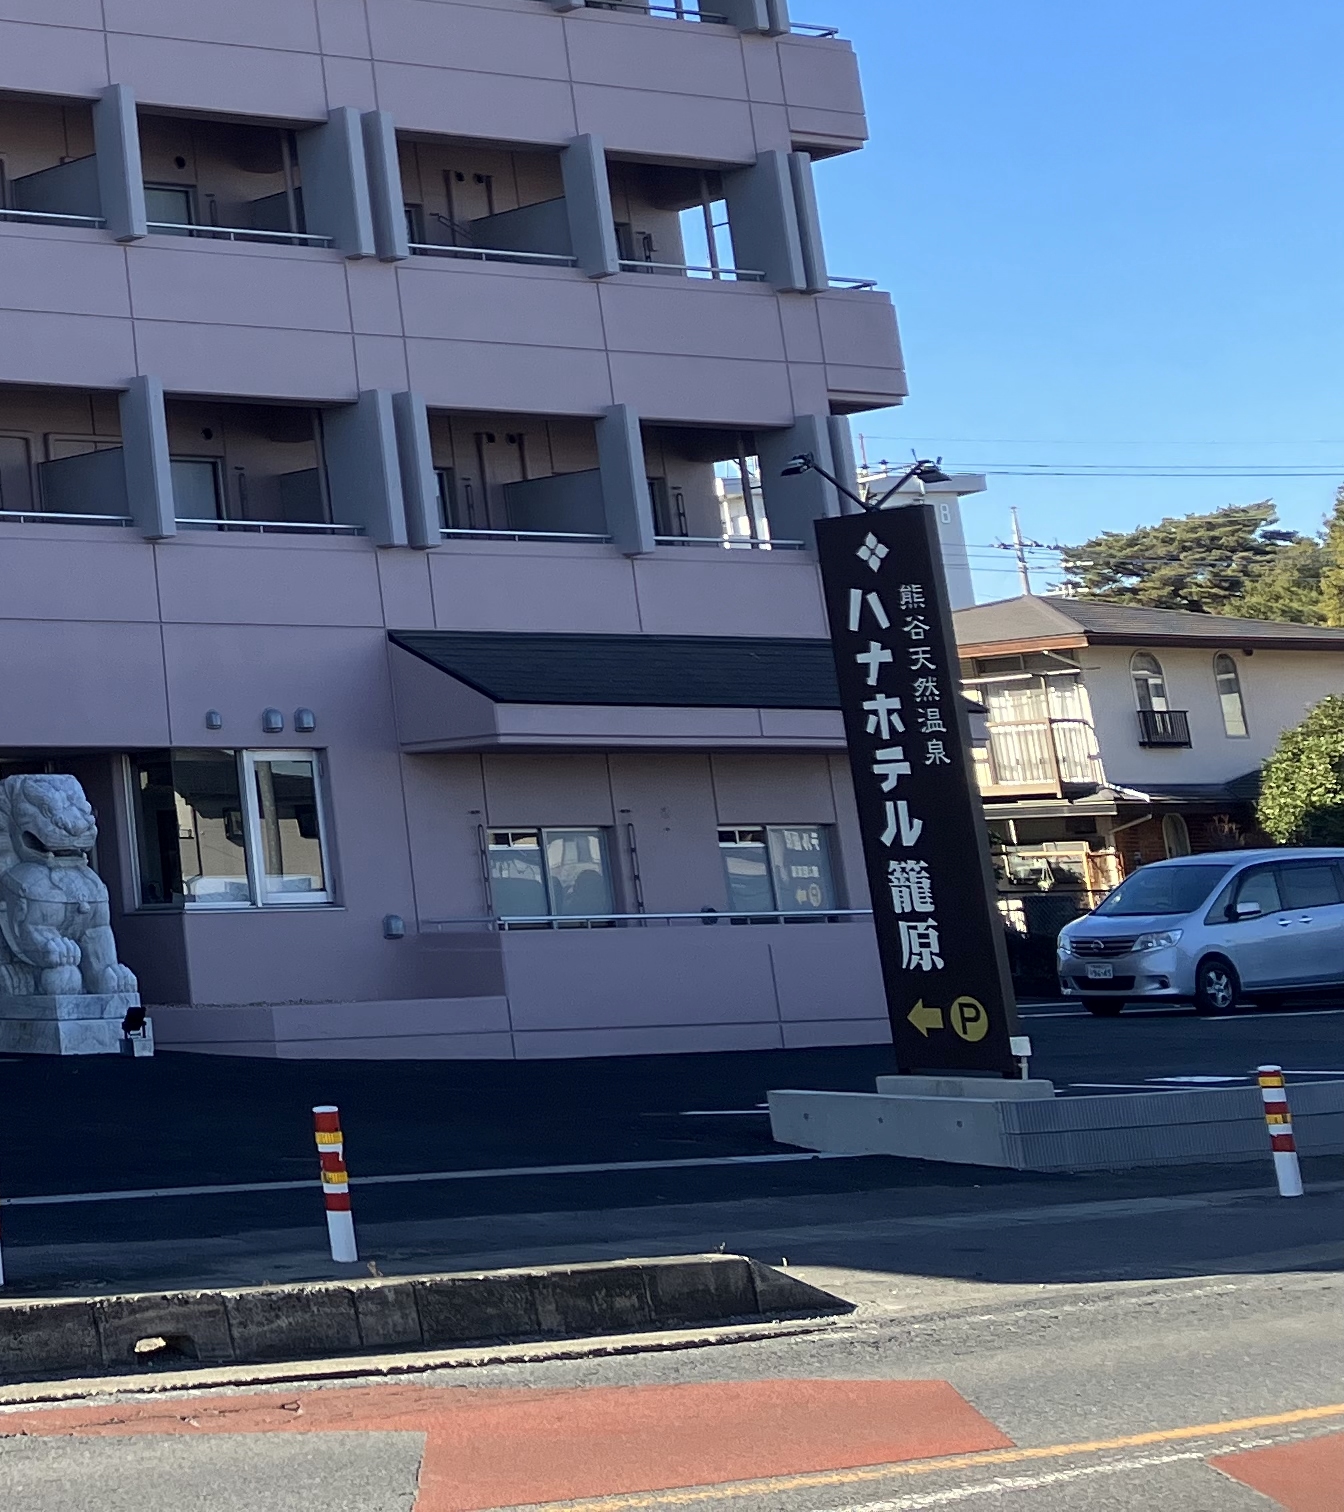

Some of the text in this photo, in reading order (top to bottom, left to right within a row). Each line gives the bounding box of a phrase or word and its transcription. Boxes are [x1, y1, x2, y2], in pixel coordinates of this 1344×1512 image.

[940, 503, 951, 524] 8
[898, 583, 952, 766] 熊谷天然温泉
[847, 587, 946, 972] ハナホテル籠原
[958, 1001, 982, 1036] P
